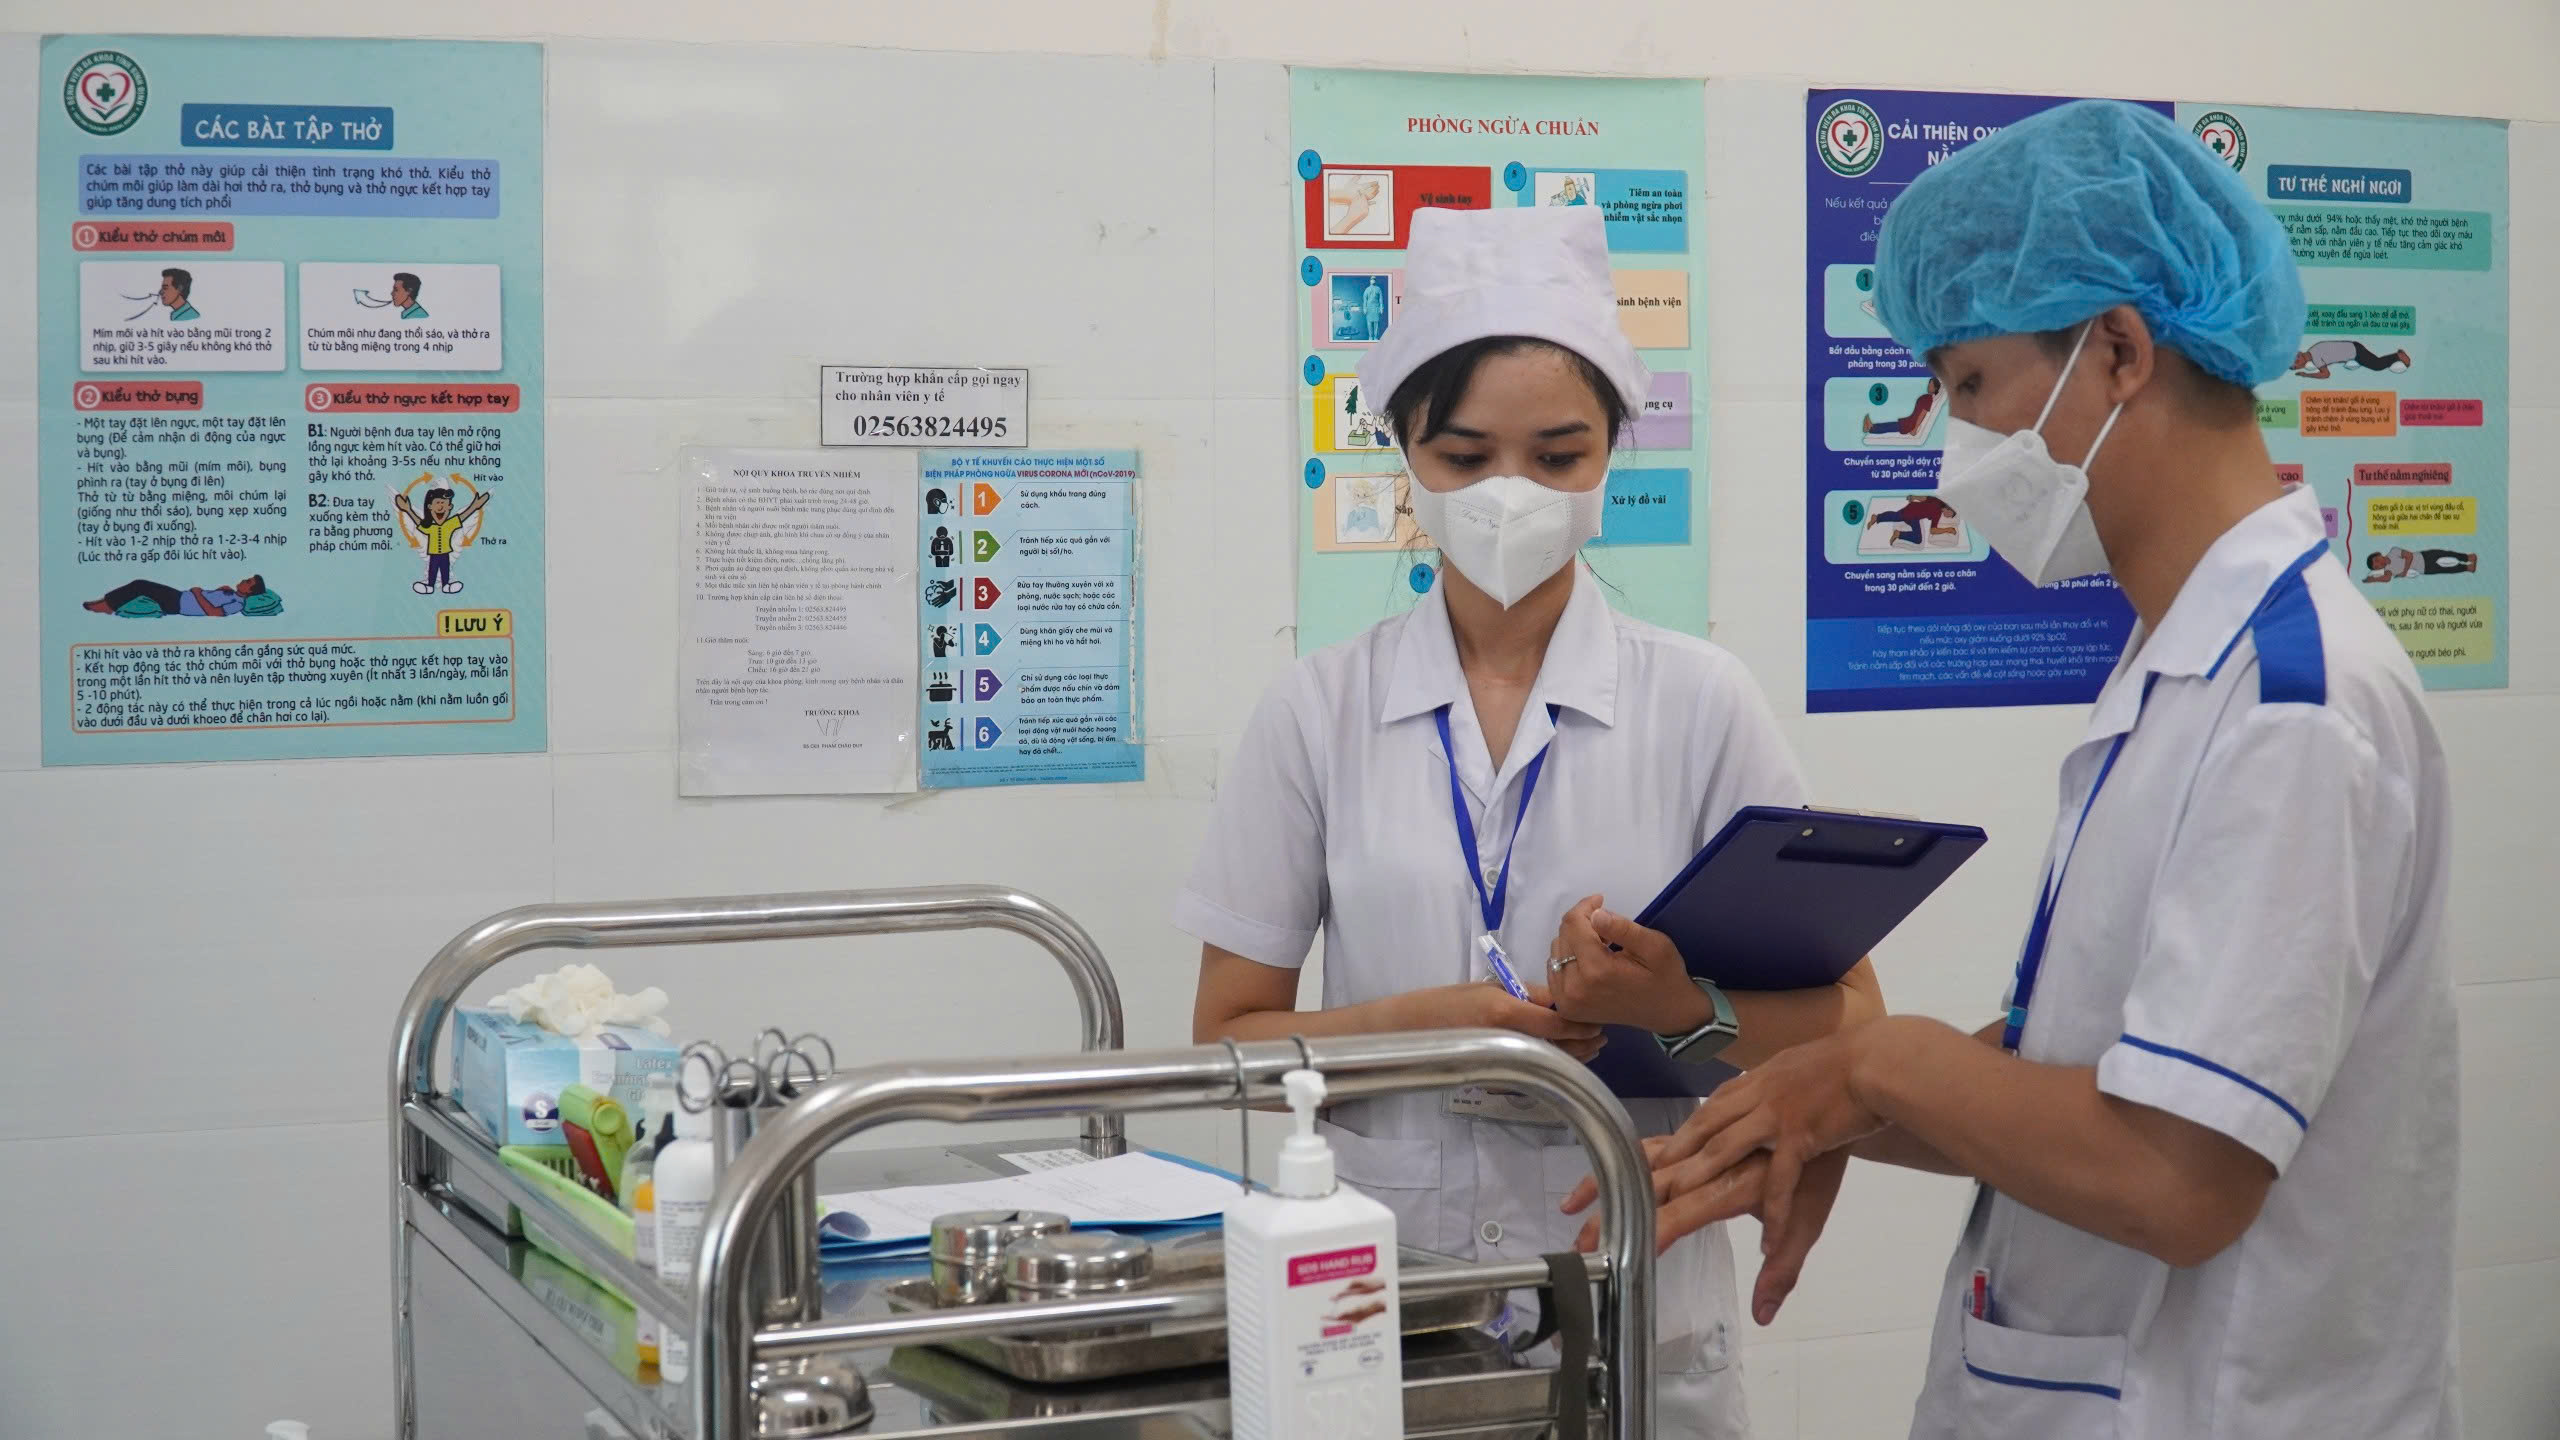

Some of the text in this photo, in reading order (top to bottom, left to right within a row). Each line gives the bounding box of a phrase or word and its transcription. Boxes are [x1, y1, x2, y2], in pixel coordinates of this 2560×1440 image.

[195, 114, 382, 143] CÁC BÀI TẬP THỞ
[1408, 113, 1598, 135] PHÒNG NGỪA CHUẨN
[1888, 119, 1918, 139] CẢI
[1923, 122, 1968, 145] THIỆN
[86, 162, 490, 180] Các bài tập thở này giúp cải thiện tình trạng khó thở. Kiểu thở
[1628, 188, 1650, 196] Tiêm
[1664, 188, 1682, 197] toàn
[2278, 175, 2401, 195] TƯ THẾ NGHỈ NGƠI
[1613, 200, 1638, 211] phòng
[1641, 200, 1661, 211] ngừa
[1664, 201, 1682, 211] phơi
[1825, 196, 1889, 211] Nếu kết quả
[1604, 211, 1682, 224] nhiễm vật sắc nhọn
[99, 227, 128, 242] Kiểu
[132, 229, 158, 242] thở
[162, 230, 198, 242] chúm
[202, 229, 226, 242] môi
[1864, 274, 1869, 287] 1
[1616, 296, 1681, 308] sinh bệnh viện
[835, 370, 1020, 387] Trường hợp khẩn cấp gọi ngay
[102, 386, 131, 402] Kiểu
[135, 389, 161, 401] thở
[165, 390, 198, 405] bụng
[333, 390, 361, 404] Kiểu
[365, 391, 390, 404] thở
[393, 395, 426, 407] ngực
[430, 390, 453, 404] kết
[456, 393, 482, 406] hợp
[486, 393, 510, 407] tay
[835, 388, 944, 404] cho nhân viên y tế
[1876, 387, 1882, 401] 3
[854, 415, 1007, 437] 02563824495
[952, 456, 963, 466] BỘ
[972, 456, 980, 465] TẾ
[982, 456, 1012, 465] KHUYẾN
[1014, 456, 1032, 465] CÁO
[1034, 458, 1054, 466] THỰC
[1056, 456, 1073, 466] HIỆN
[1075, 456, 1092, 466] MỘT
[1094, 456, 1104, 465] SỐ
[733, 469, 749, 478] NỘI
[925, 469, 1136, 479] BIỆN PHÁP PHÒNG NGỪA VIRUS CORONA MỚI (nCoV-2019)
[2281, 473, 2299, 481] cao
[2358, 468, 2448, 482] Tư thế nằm nghiêng
[978, 492, 985, 506] 1
[1611, 493, 1666, 506] Xử lý đồ vải
[1849, 505, 1857, 520] 5
[977, 539, 987, 554] 2
[1844, 569, 1874, 580] Chuyển
[1876, 572, 1895, 580] sang
[1897, 569, 1915, 578] nằm
[1916, 568, 1931, 579] sấp
[1932, 568, 1943, 577] và
[1956, 568, 1976, 577] chân
[978, 586, 988, 601] 3
[1864, 581, 1956, 593] trong 30 phút đến 2 giờ.
[456, 618, 486, 632] LƯU
[494, 613, 503, 631] Ý
[979, 632, 989, 646] 4
[979, 677, 989, 692] 5
[979, 727, 989, 741] 6
[535, 1100, 548, 1118] S
